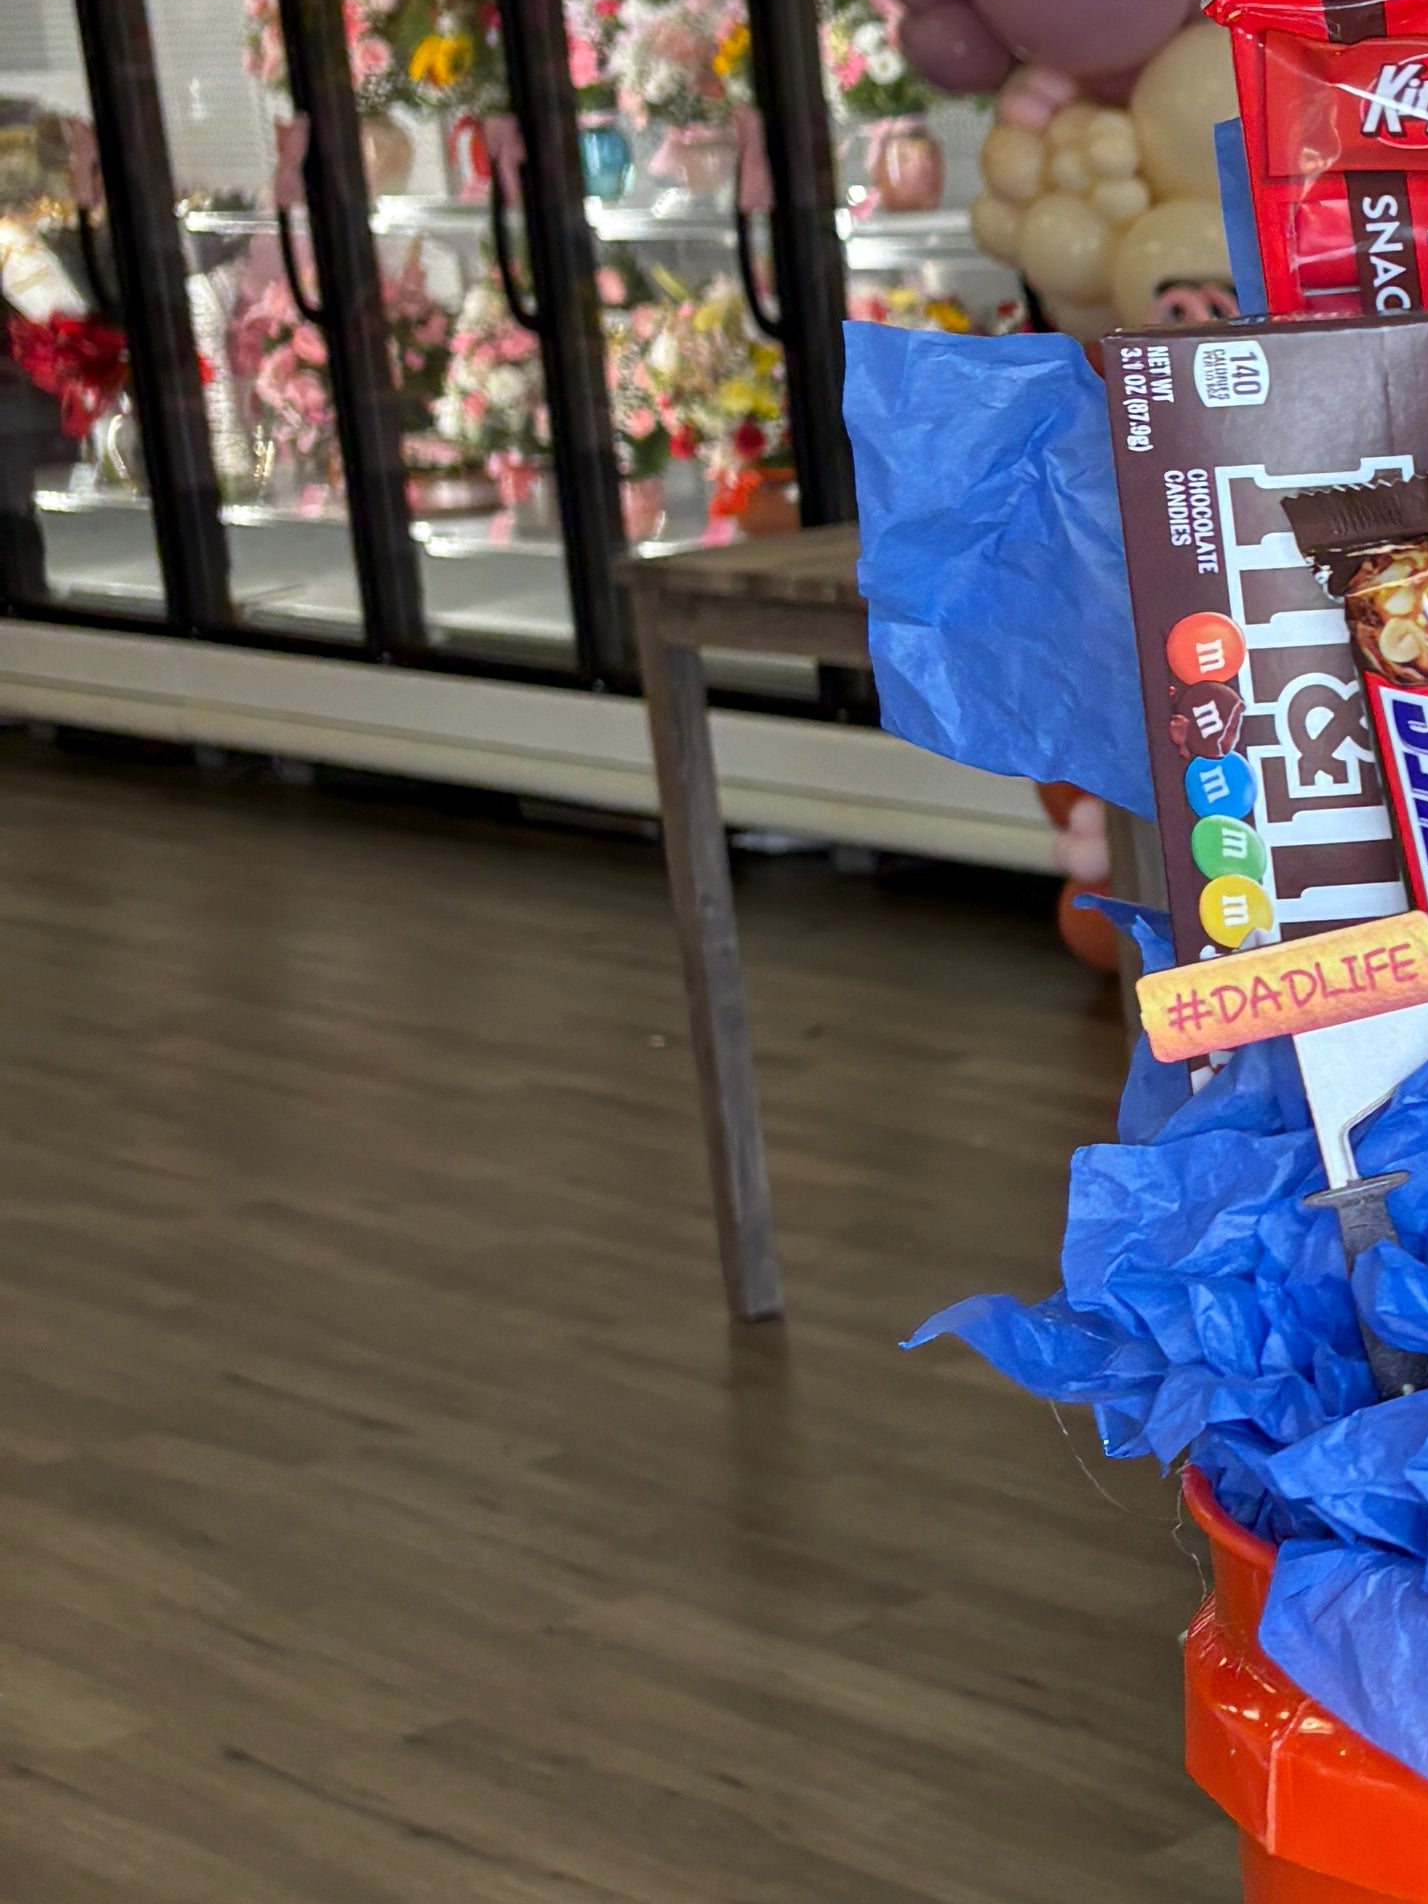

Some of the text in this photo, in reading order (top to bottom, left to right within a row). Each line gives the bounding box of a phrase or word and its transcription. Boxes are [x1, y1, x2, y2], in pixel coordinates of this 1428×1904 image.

[1120, 347, 1154, 453] 3.1 OZ (87.9g)
[1147, 345, 1176, 404] NET WT
[1229, 350, 1262, 396] 140
[1163, 469, 1192, 547] CANDIES
[1186, 468, 1219, 575] CHOCOLATE
[1167, 942, 1420, 1033] #DADLIFE
